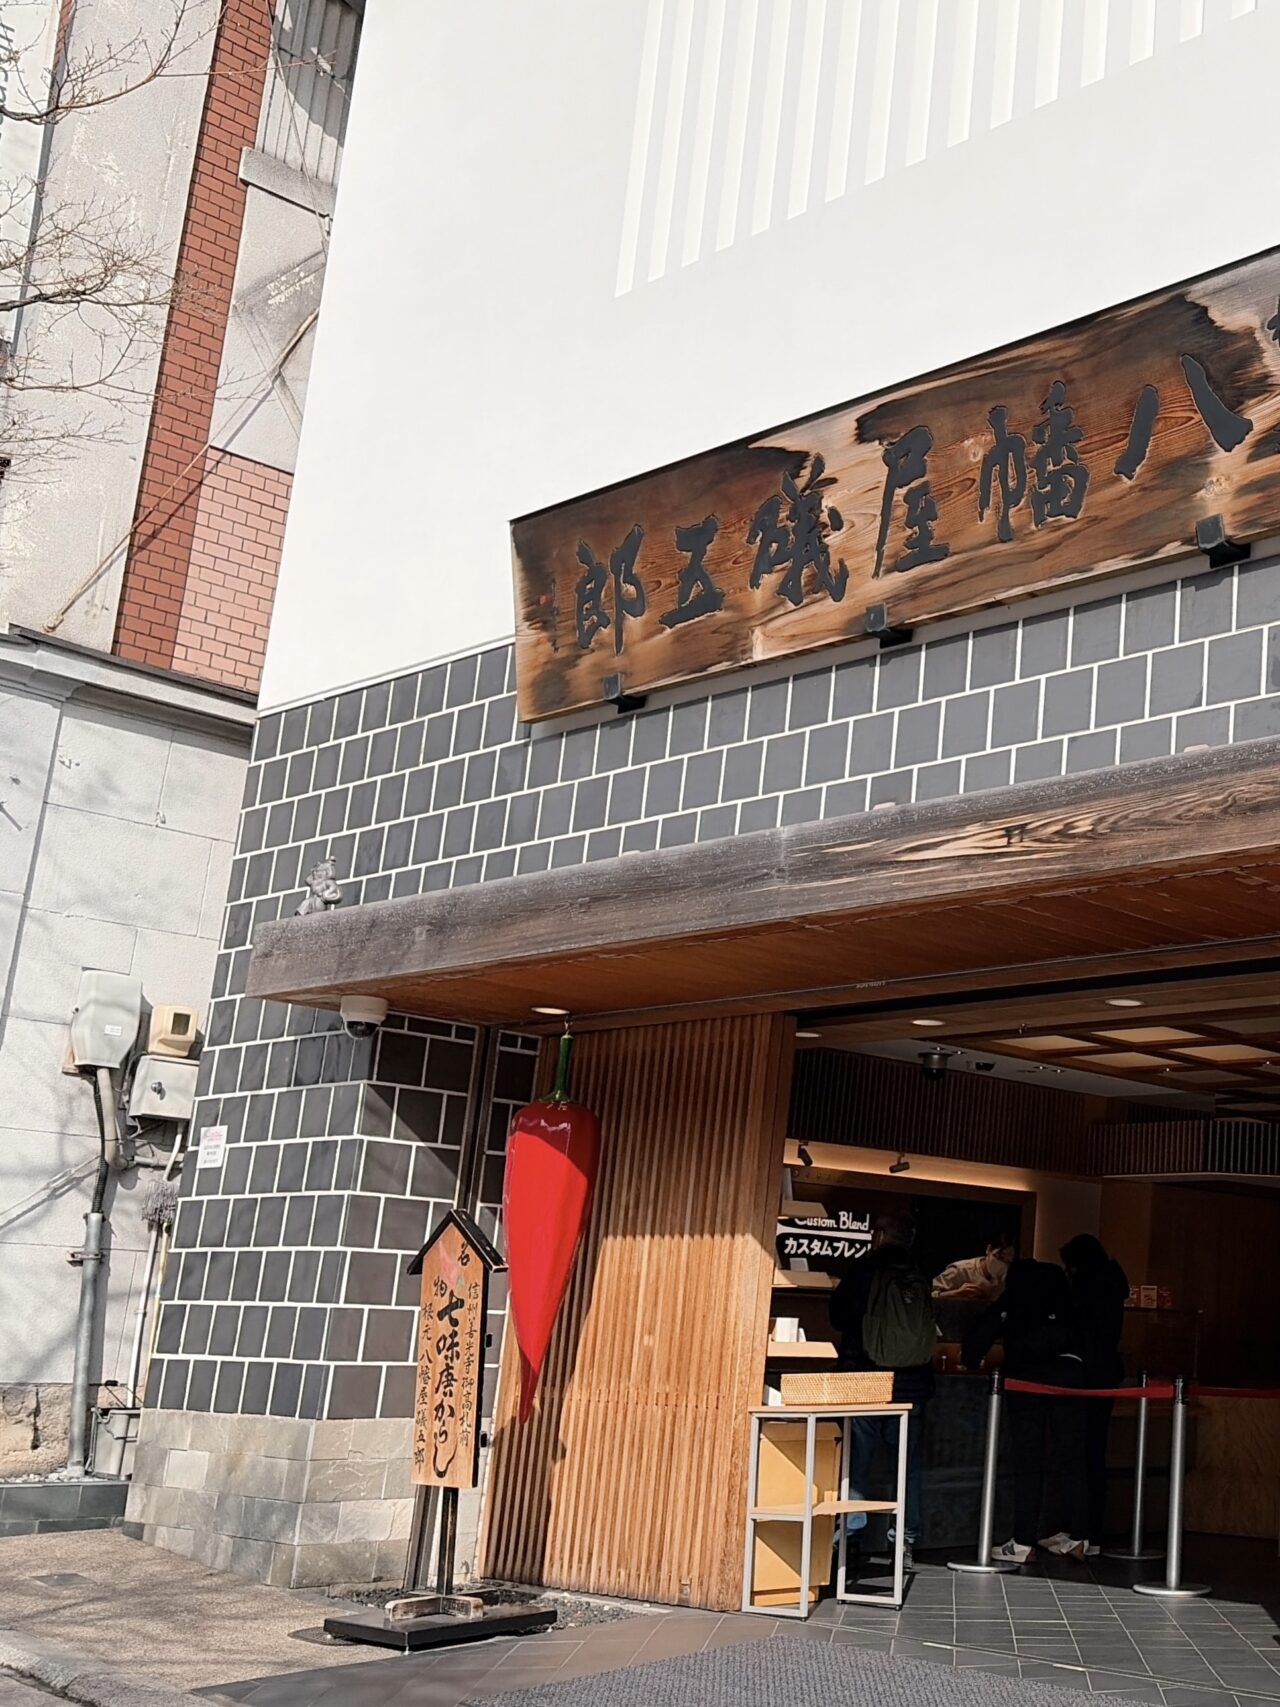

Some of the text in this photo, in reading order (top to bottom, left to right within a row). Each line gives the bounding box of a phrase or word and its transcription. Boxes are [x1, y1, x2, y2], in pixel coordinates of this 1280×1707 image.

[838, 1210, 870, 1231] Blend
[784, 1237, 872, 1259] カスタムブレン
